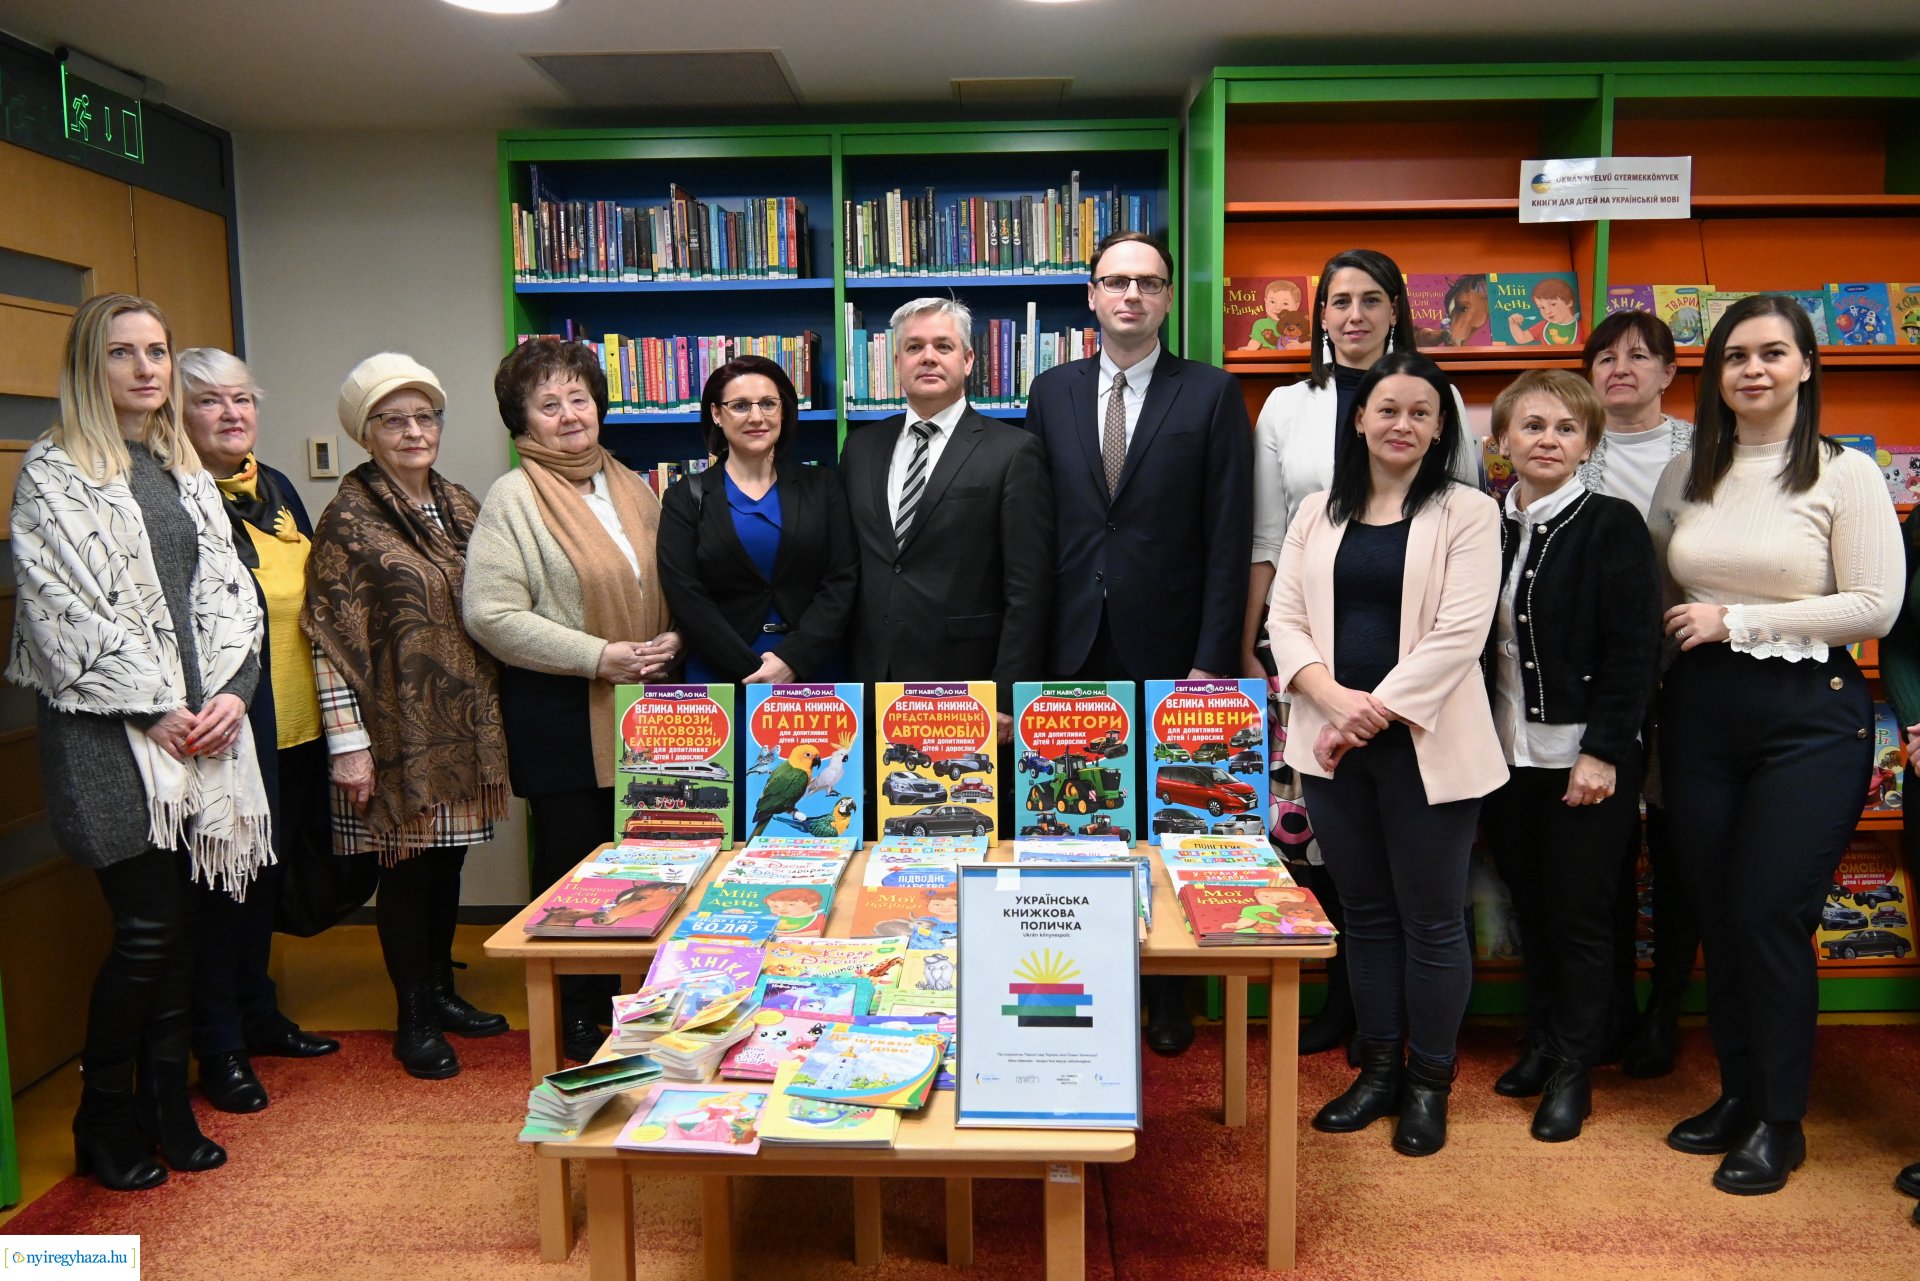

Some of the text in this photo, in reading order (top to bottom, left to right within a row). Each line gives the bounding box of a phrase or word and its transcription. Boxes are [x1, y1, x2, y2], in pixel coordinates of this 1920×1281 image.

[1614, 173, 1679, 182] GYERMEKKÖNYVEK
[1531, 198, 1558, 207] КНИГИ
[1558, 198, 1575, 206] ДЛЯ
[1576, 195, 1598, 205] ДІТЕЙ
[1612, 195, 1659, 204] УКРАЇНСЬКІЙ
[1496, 284, 1526, 296] Мій
[1228, 290, 1257, 302] Мої
[764, 702, 846, 712] ВЕЛИКА КНИЖКА
[896, 701, 979, 711] ВЕЛИКА КНИЖКА
[1033, 702, 1117, 712] ВЕЛИКА КНИЖКА
[1166, 698, 1250, 708] ВЕЛИКА КНИЖКА
[635, 704, 718, 714] ВЕЛИКА КНИЖКА
[888, 711, 984, 722] ПРЕДСТАВНИЦЬКІ
[1162, 710, 1253, 726] МІНІВЕНИ
[762, 715, 848, 729] ПАПУГИ
[1025, 715, 1122, 729] ТРАКТОРИ
[891, 722, 985, 738] АВТОМОБІЛІ
[630, 737, 721, 747] ЕЛЕКТРОВОЗИ
[898, 875, 946, 883] ПІДВОДНЕ
[719, 889, 759, 898] Мій
[1016, 893, 1089, 905] УКРАЇНСЬКА
[1003, 909, 1075, 918] КНИЖКОВА
[1021, 922, 1082, 930] ПОЛИЧКА
